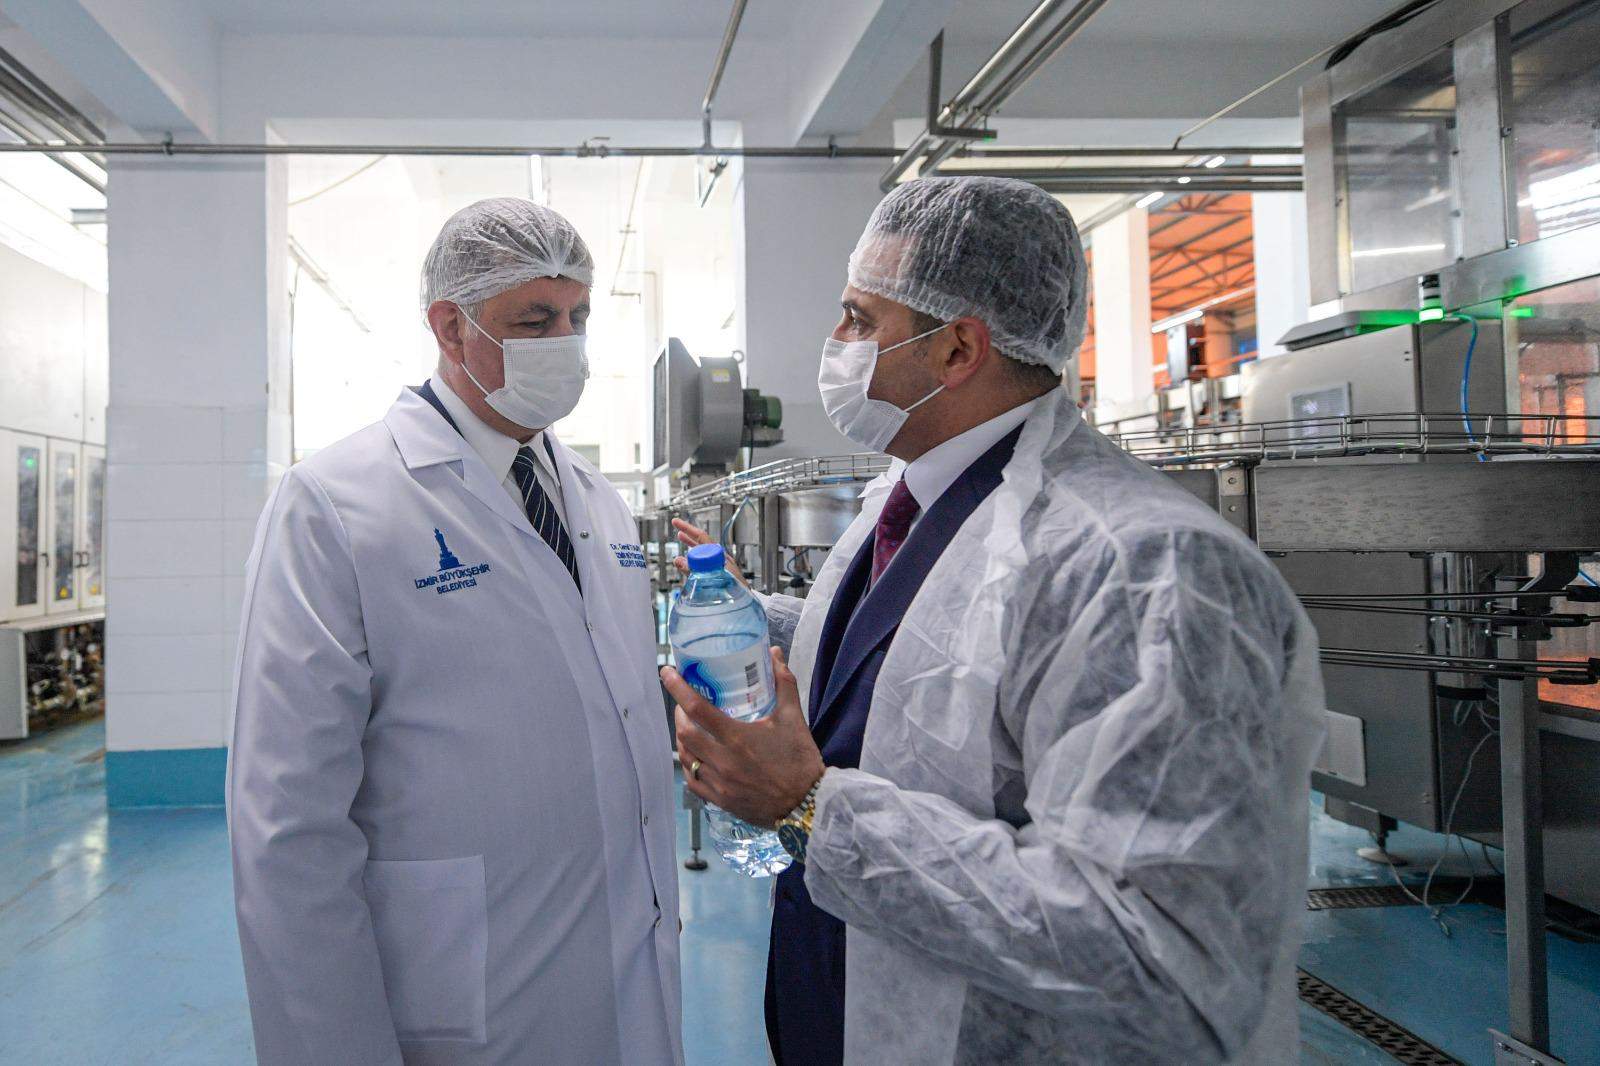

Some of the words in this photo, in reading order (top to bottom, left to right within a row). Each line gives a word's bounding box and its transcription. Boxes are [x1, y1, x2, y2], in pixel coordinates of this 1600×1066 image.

[414, 575, 439, 589] İZMİR
[439, 563, 491, 583] BÜYÜKŞEHİR
[436, 577, 478, 594] BELEDİYESİ
